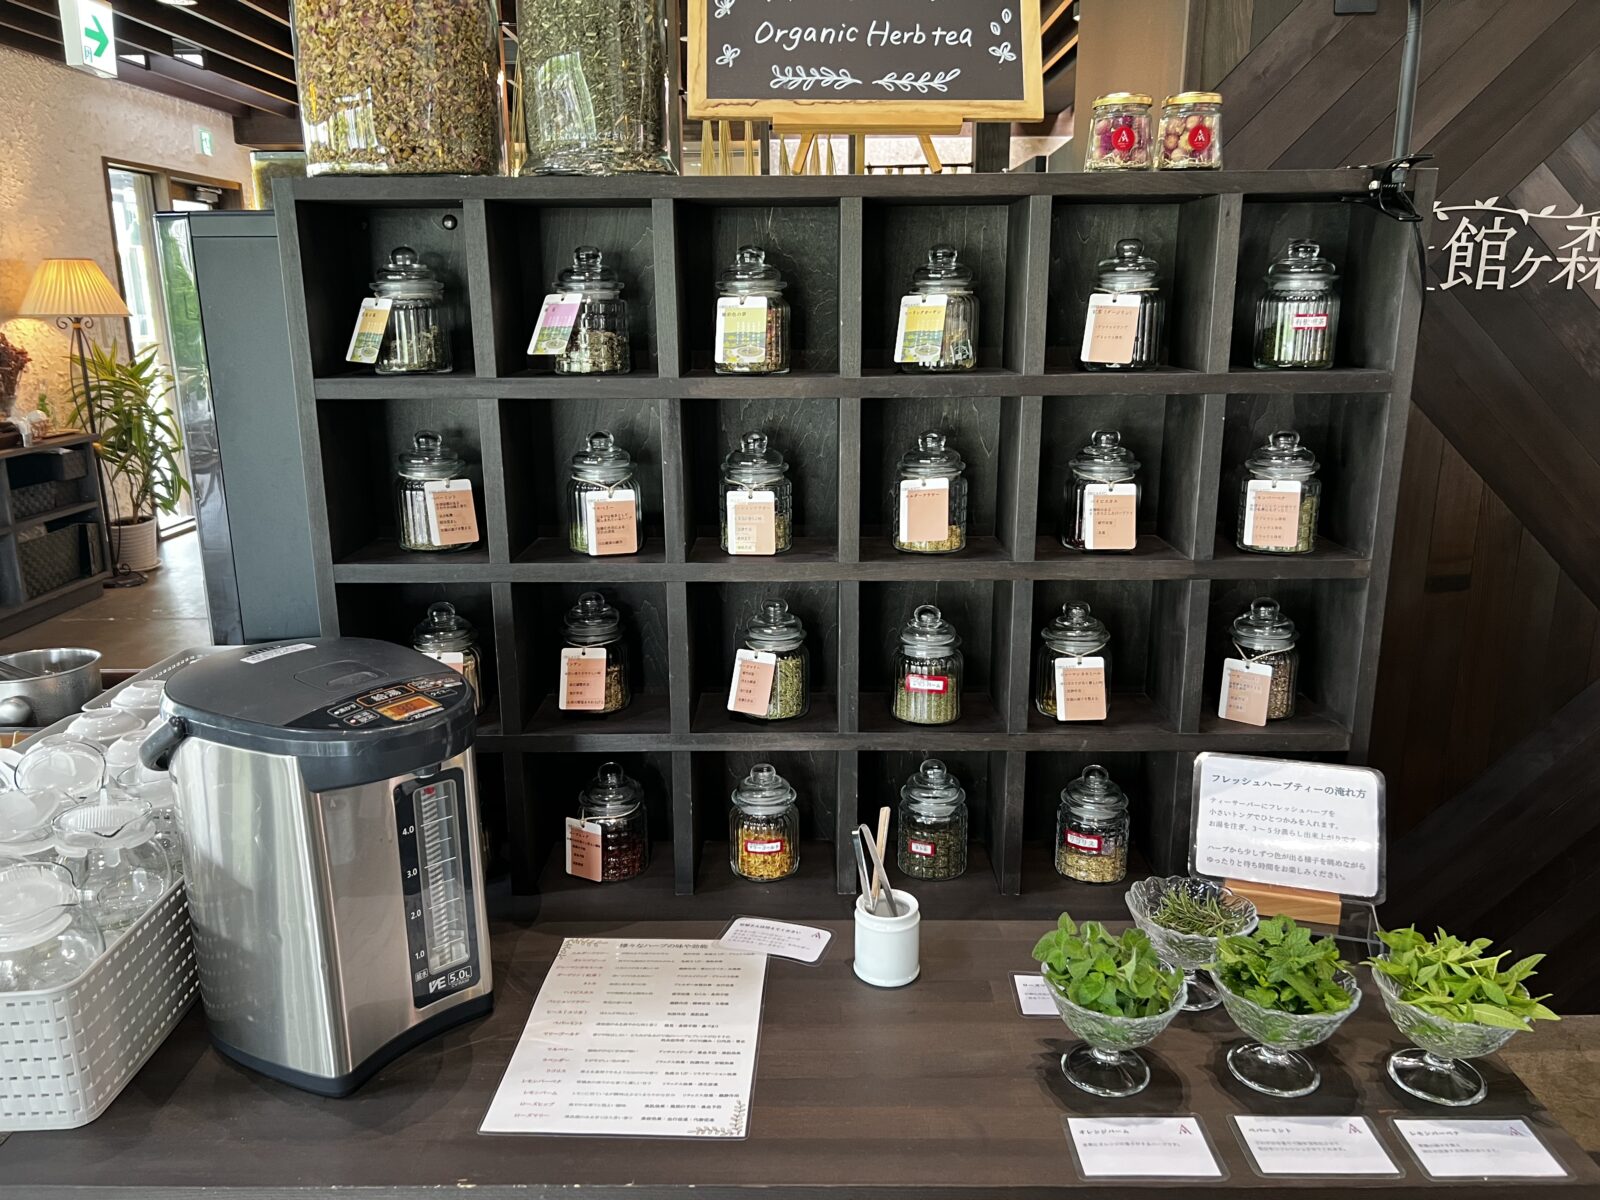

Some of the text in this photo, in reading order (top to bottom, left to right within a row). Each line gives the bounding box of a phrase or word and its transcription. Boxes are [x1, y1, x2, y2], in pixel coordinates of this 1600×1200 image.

[754, 20, 973, 51] Organic Herb tea
[1211, 773, 1367, 800] フレッシュハーブティーの淹れ方
[402, 826, 416, 837] 4.0
[406, 868, 418, 879] 3.0
[410, 910, 422, 921] 2.0
[414, 950, 426, 961] 1.0
[449, 969, 471, 984] 5.0L
